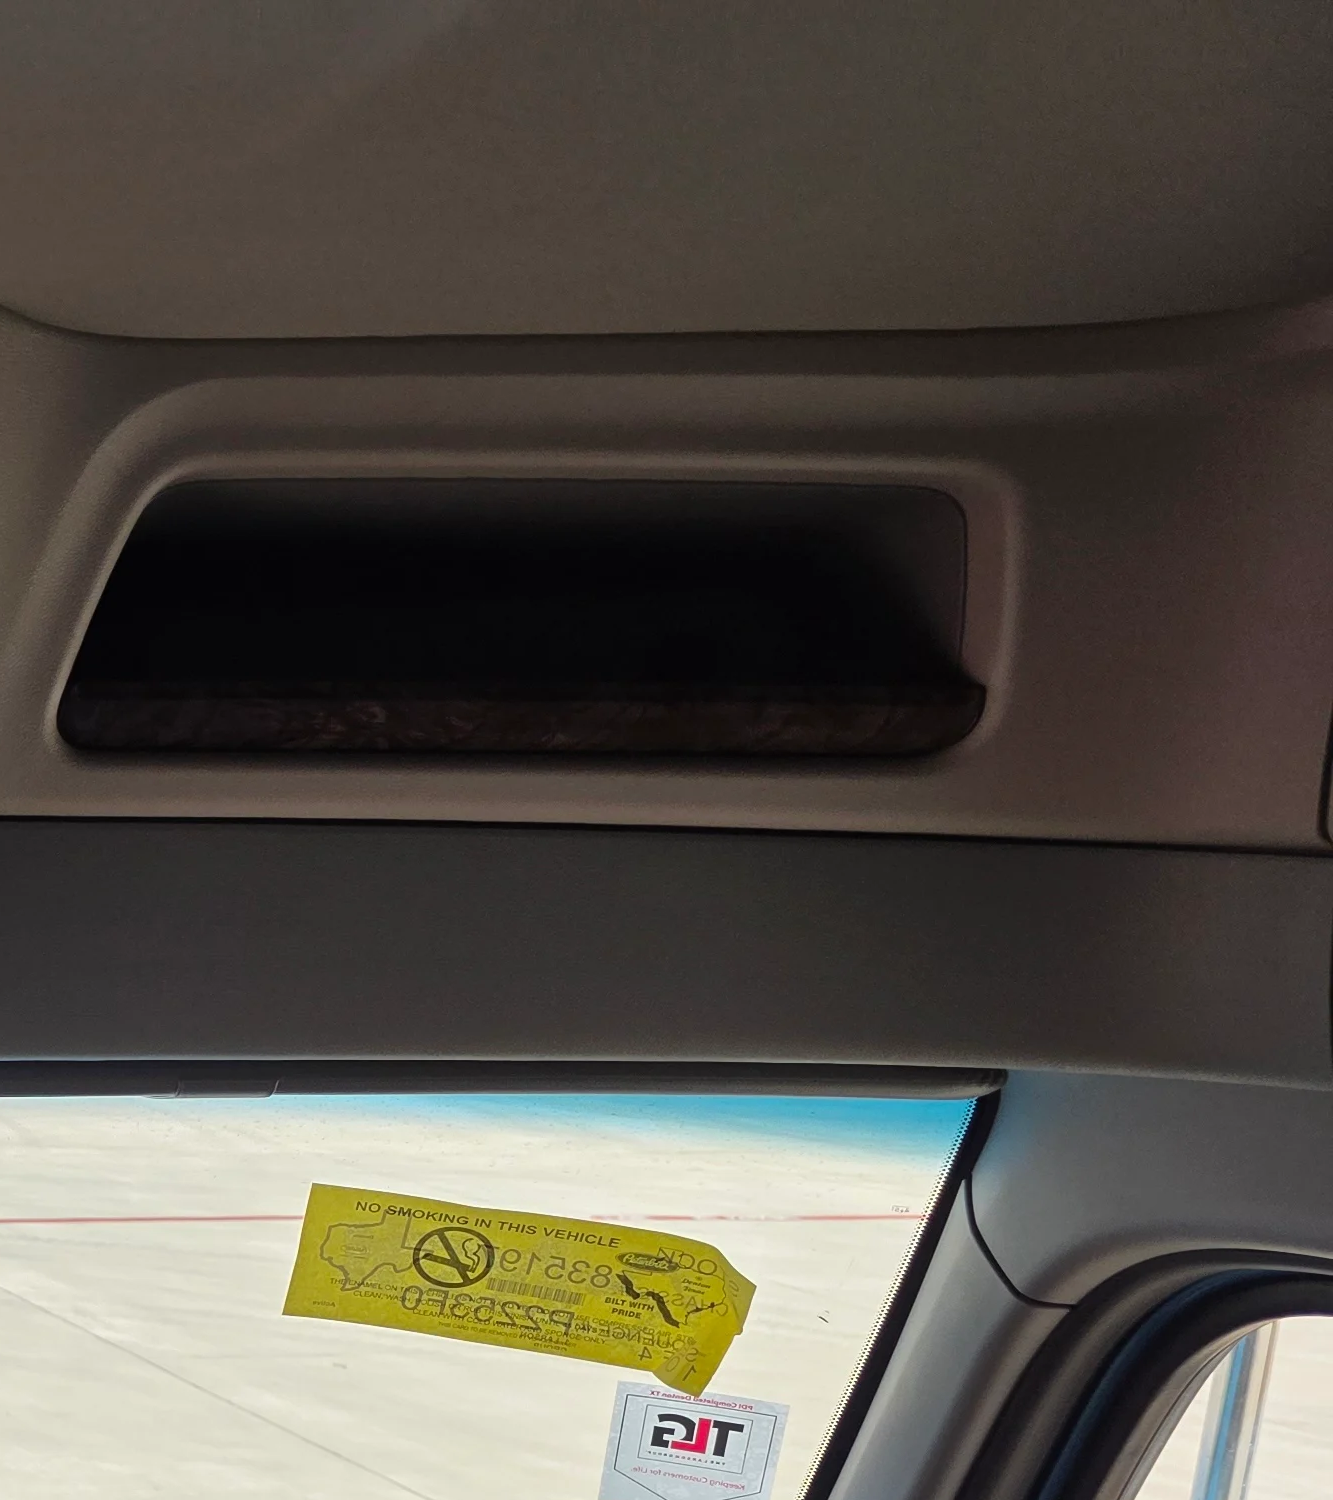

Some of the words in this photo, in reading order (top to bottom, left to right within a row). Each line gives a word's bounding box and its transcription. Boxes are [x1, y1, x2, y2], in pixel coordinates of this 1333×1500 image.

[355, 1201, 381, 1213] NO
[385, 1205, 469, 1226] SMOKING
[474, 1217, 492, 1229] IN
[498, 1220, 538, 1235] THIS
[543, 1227, 622, 1249] VEHICLE
[604, 1296, 628, 1307] BILT
[628, 1299, 655, 1312] WITH
[611, 1307, 643, 1320] PRIDE
